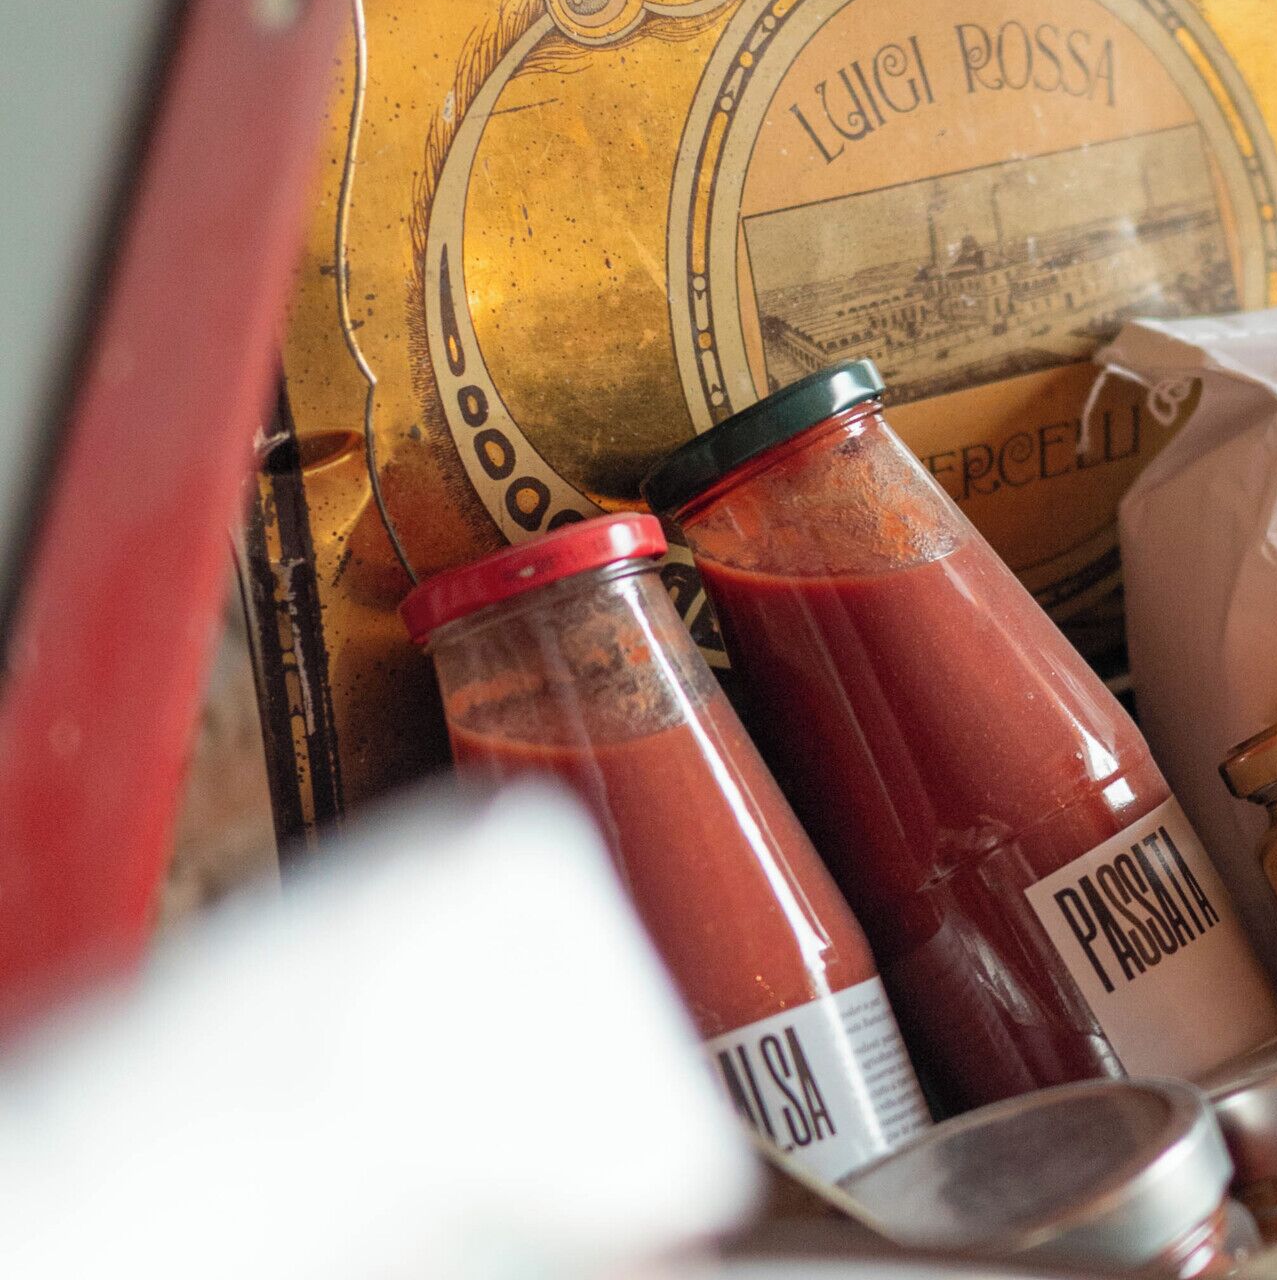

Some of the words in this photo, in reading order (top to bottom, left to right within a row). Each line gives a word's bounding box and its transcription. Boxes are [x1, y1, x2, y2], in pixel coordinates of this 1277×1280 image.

[788, 34, 937, 166] LUIGI
[953, 18, 1118, 108] ROSSA
[920, 404, 1142, 502] ERCELLI
[1053, 825, 1221, 994] PASSATA
